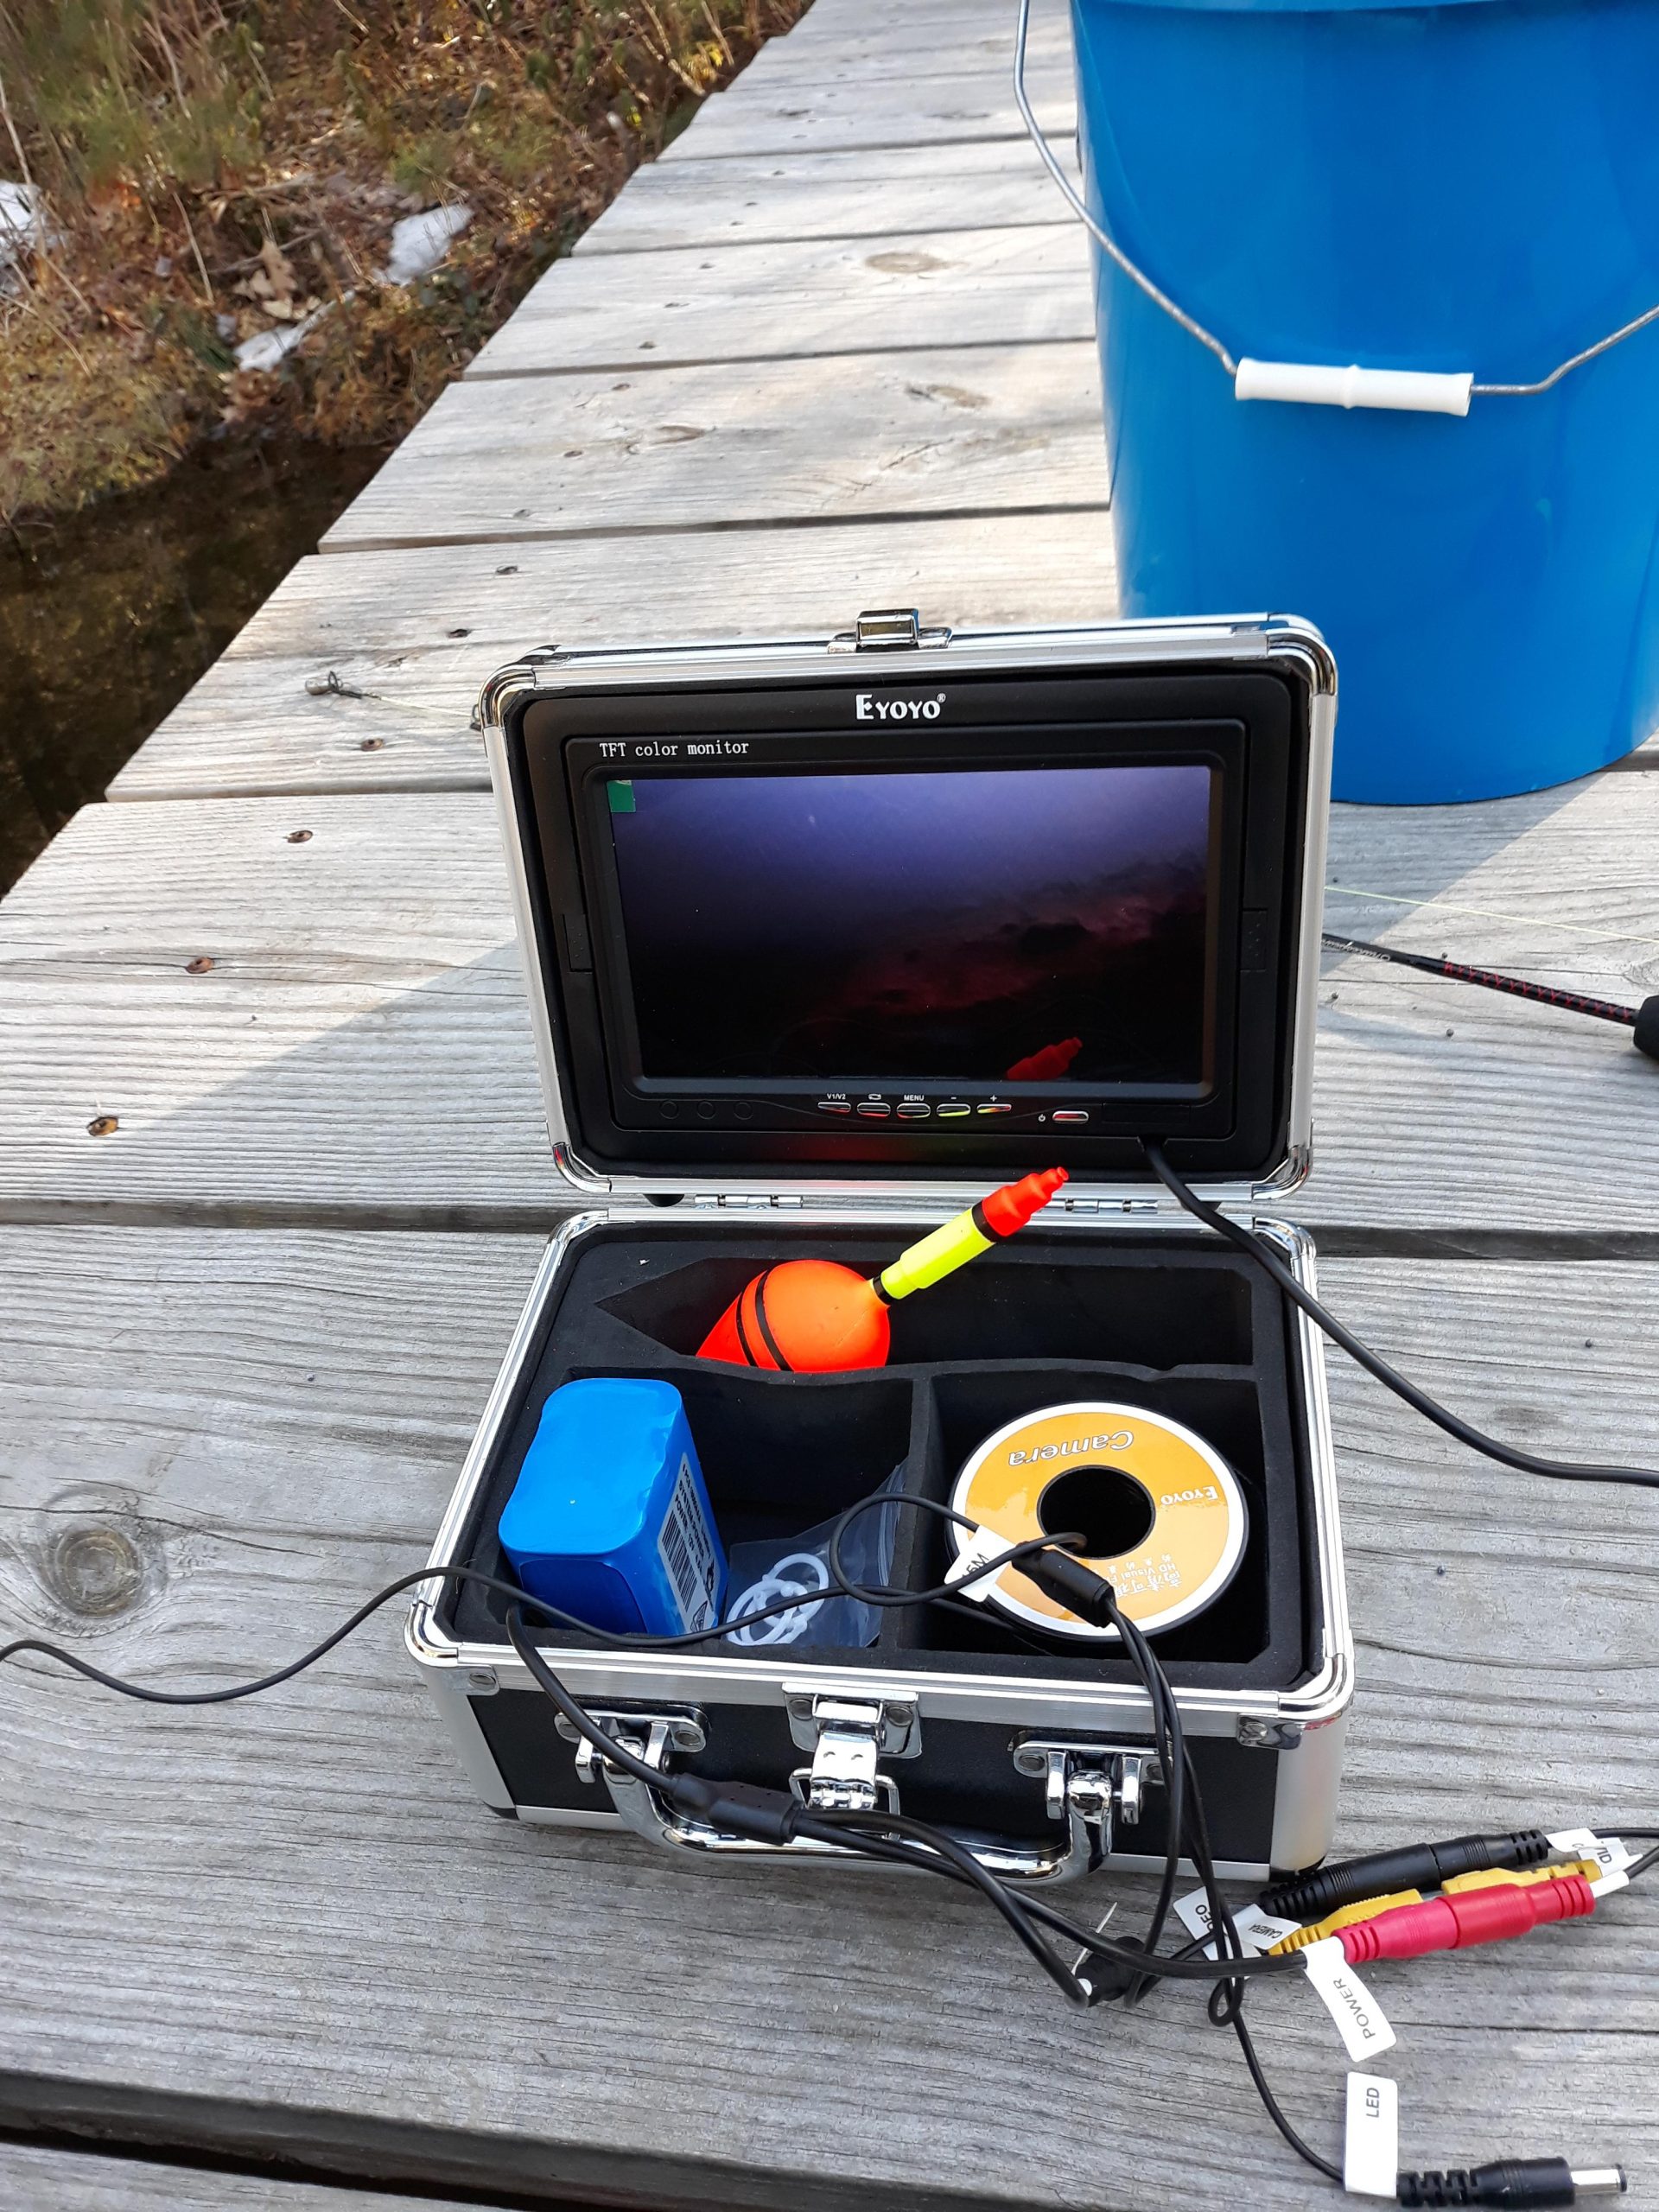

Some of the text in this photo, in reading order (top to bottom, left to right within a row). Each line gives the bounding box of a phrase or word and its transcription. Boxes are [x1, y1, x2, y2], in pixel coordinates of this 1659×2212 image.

[599, 739, 749, 757] TFT color monitor
[1007, 1430, 1135, 1466] Camera
[962, 1553, 989, 1578] 5M
[1121, 1567, 1156, 1580] Visual
[1159, 1562, 1176, 1573] HD
[1332, 1978, 1376, 2039] POWER
[1365, 2087, 1380, 2119] LED
